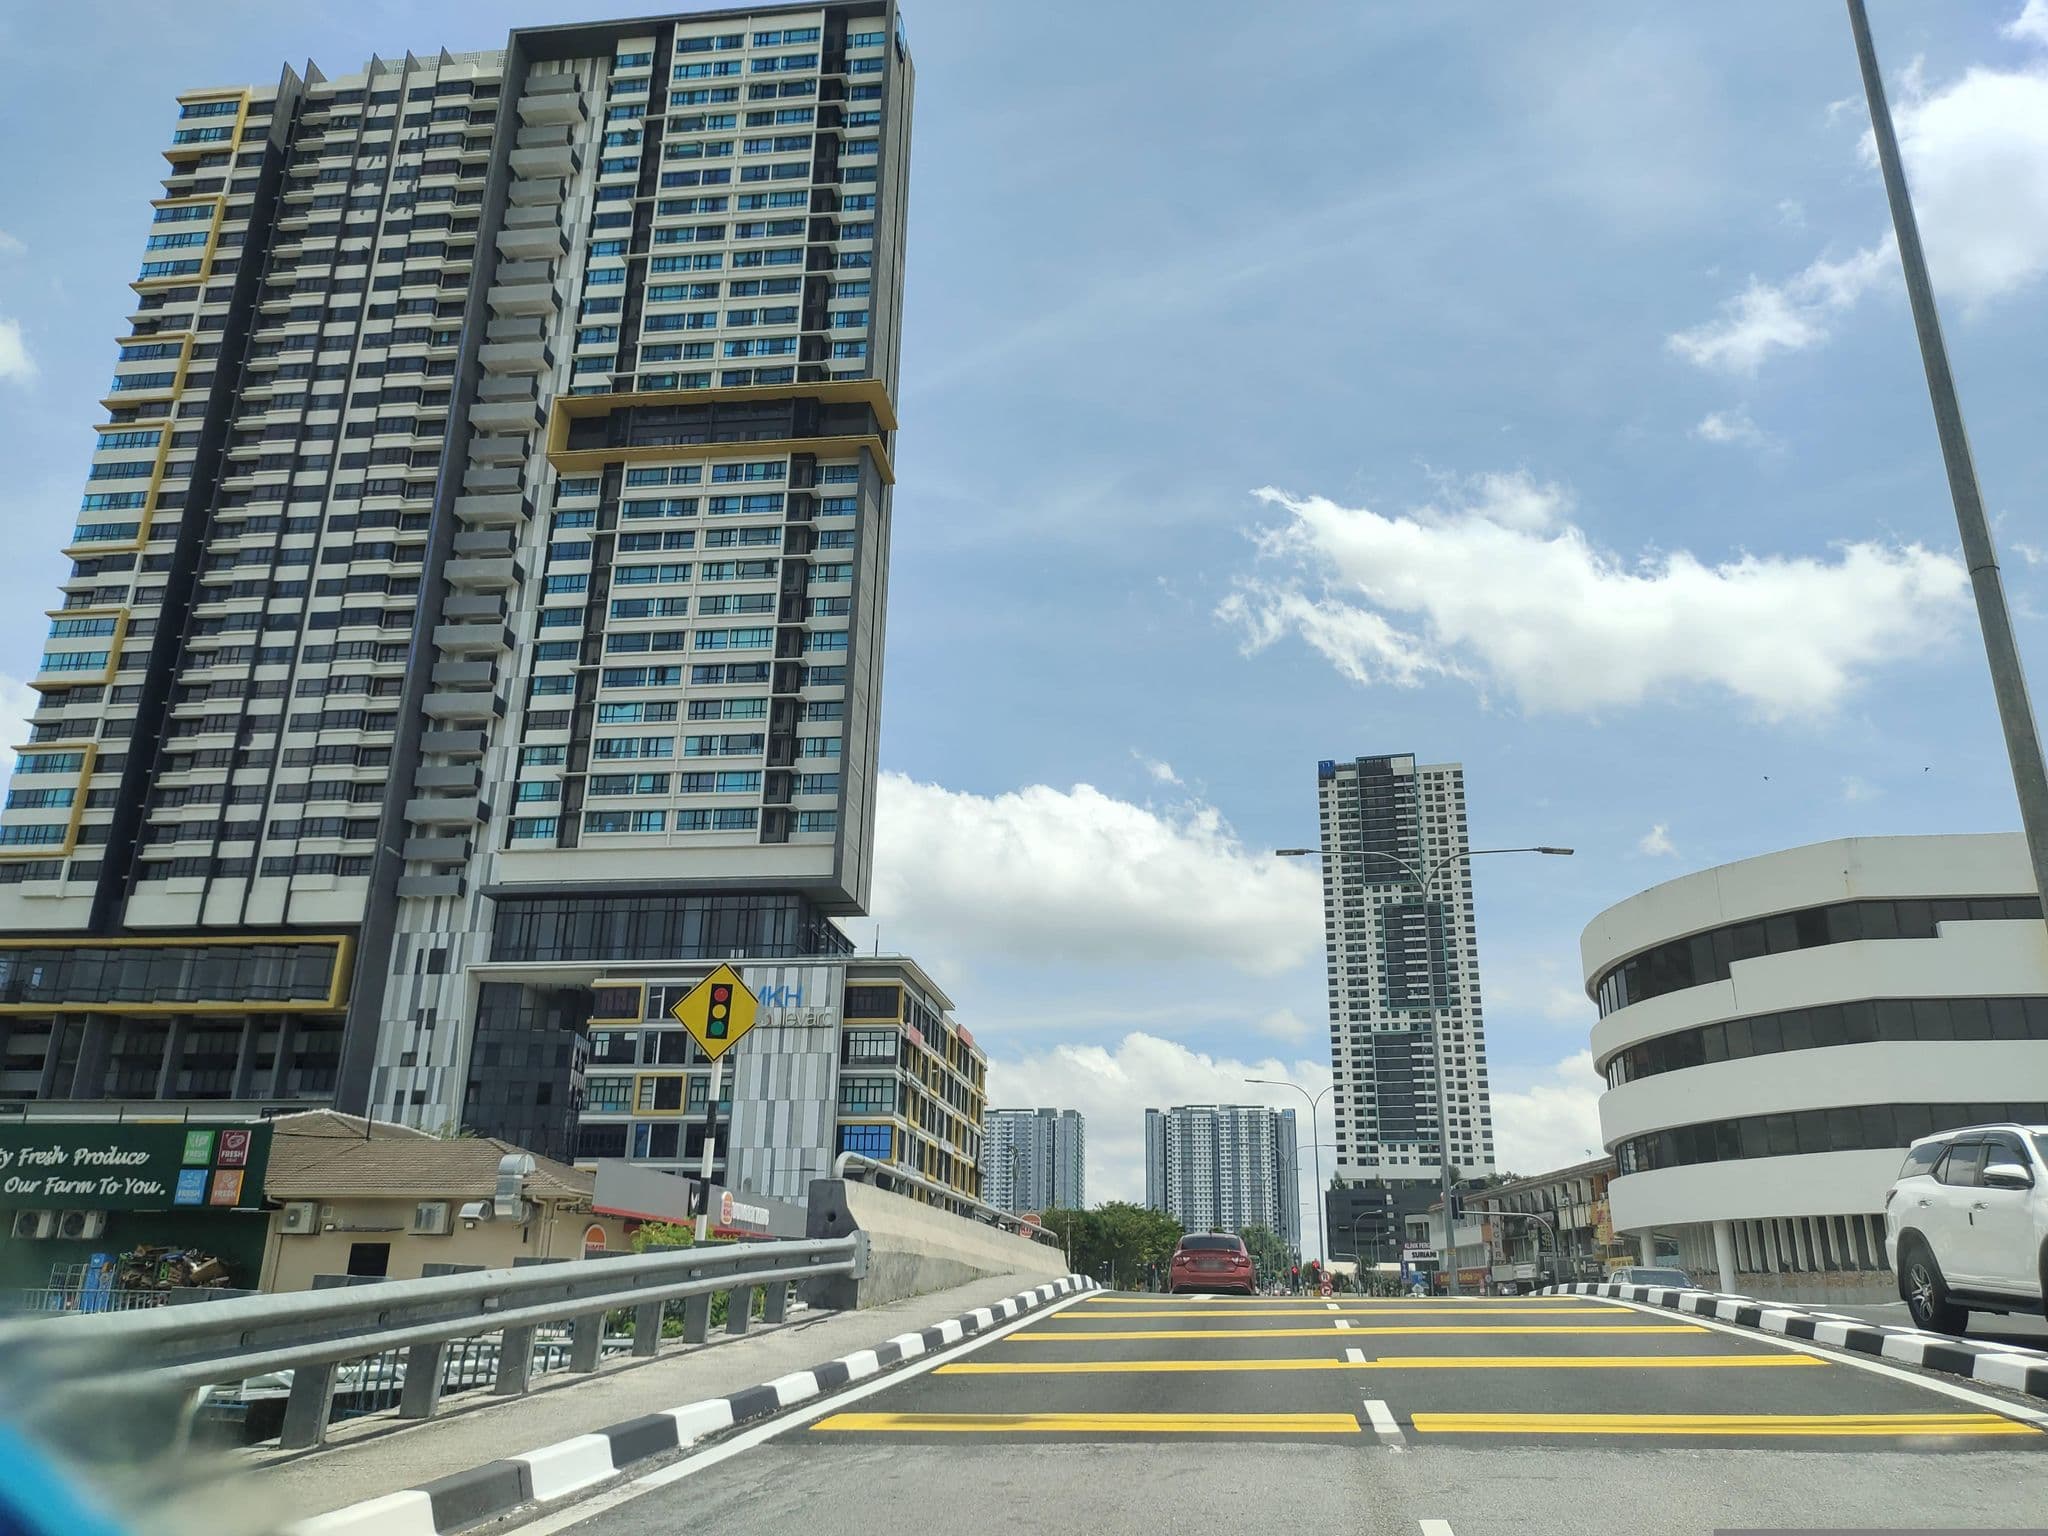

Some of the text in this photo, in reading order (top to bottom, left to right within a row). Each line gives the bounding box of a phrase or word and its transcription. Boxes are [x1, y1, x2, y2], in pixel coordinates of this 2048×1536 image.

[755, 1007, 834, 1027] oulevard
[18, 1145, 68, 1167] Fresh
[73, 1145, 150, 1166] Produce
[221, 1150, 244, 1158] FRESH
[4, 1176, 166, 1196] Our Farm To You.
